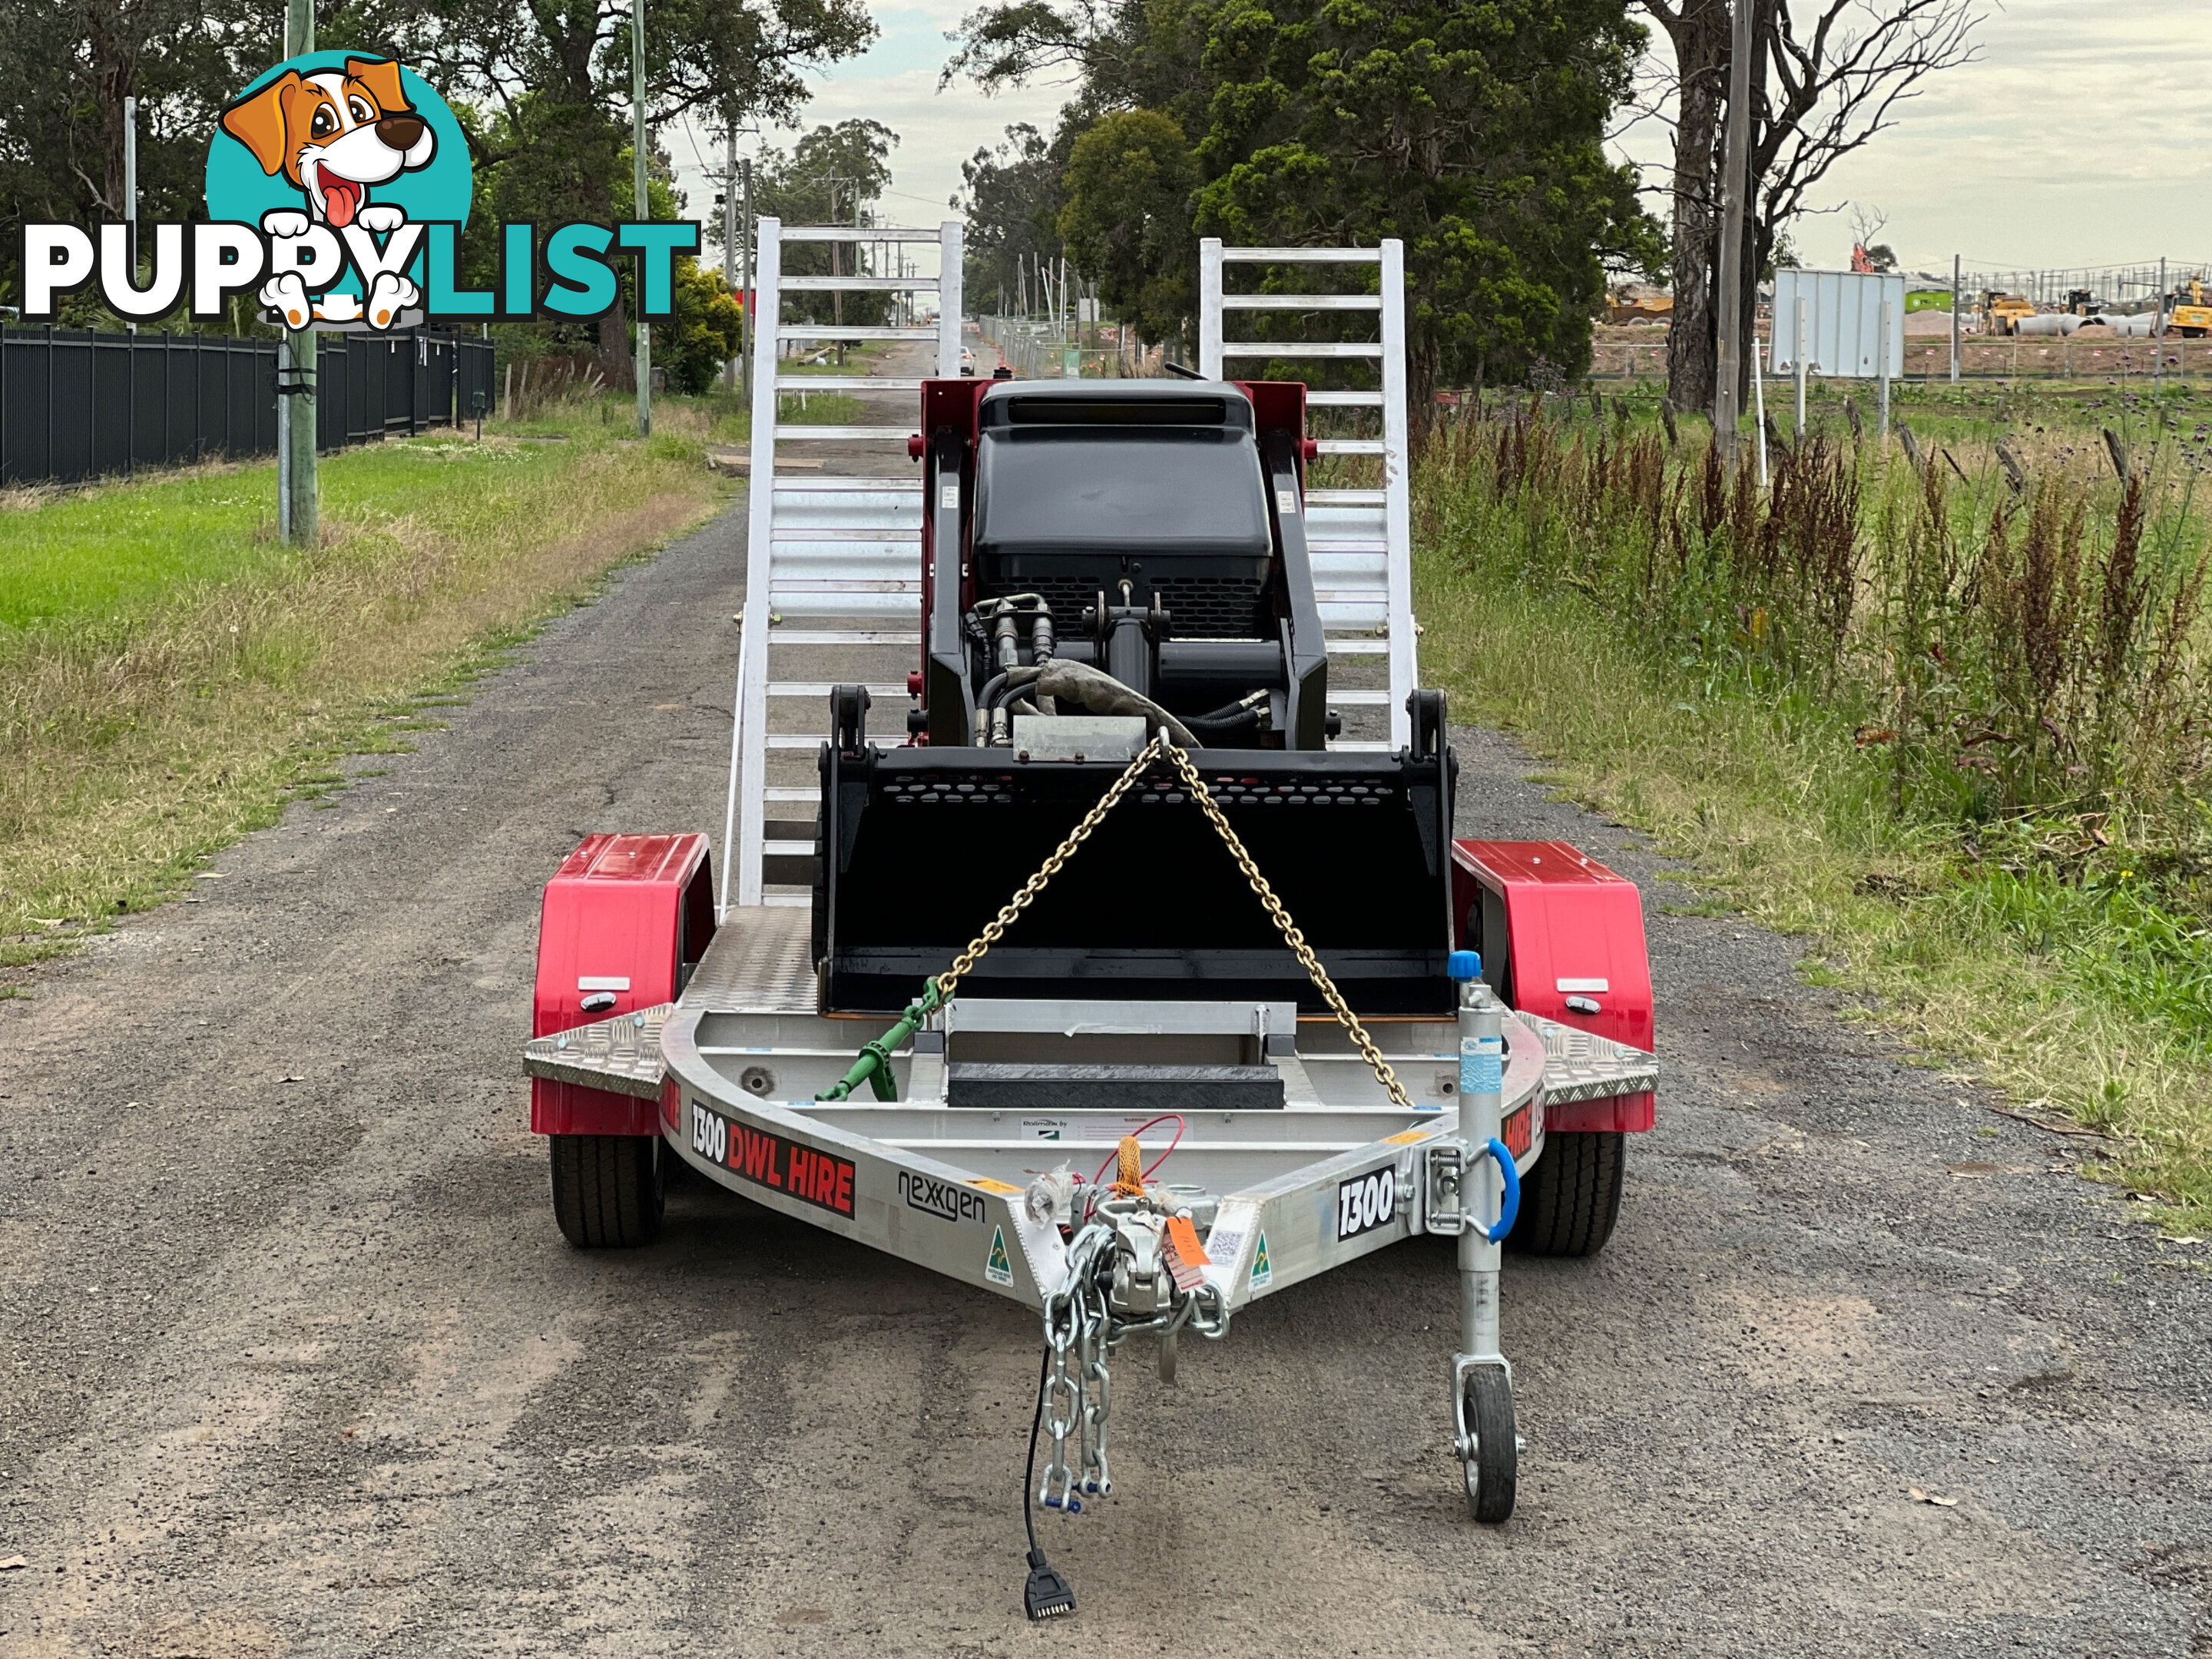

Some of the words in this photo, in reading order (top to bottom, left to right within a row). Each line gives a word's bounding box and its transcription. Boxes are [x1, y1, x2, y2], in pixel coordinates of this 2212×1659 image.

[693, 1104, 725, 1163] 1300
[728, 1123, 781, 1187] DWL
[788, 1146, 853, 1213] HIRE
[1506, 1103, 1532, 1157] HIRE
[899, 1171, 985, 1224] nexxgen
[1340, 1170, 1393, 1237] 1300
